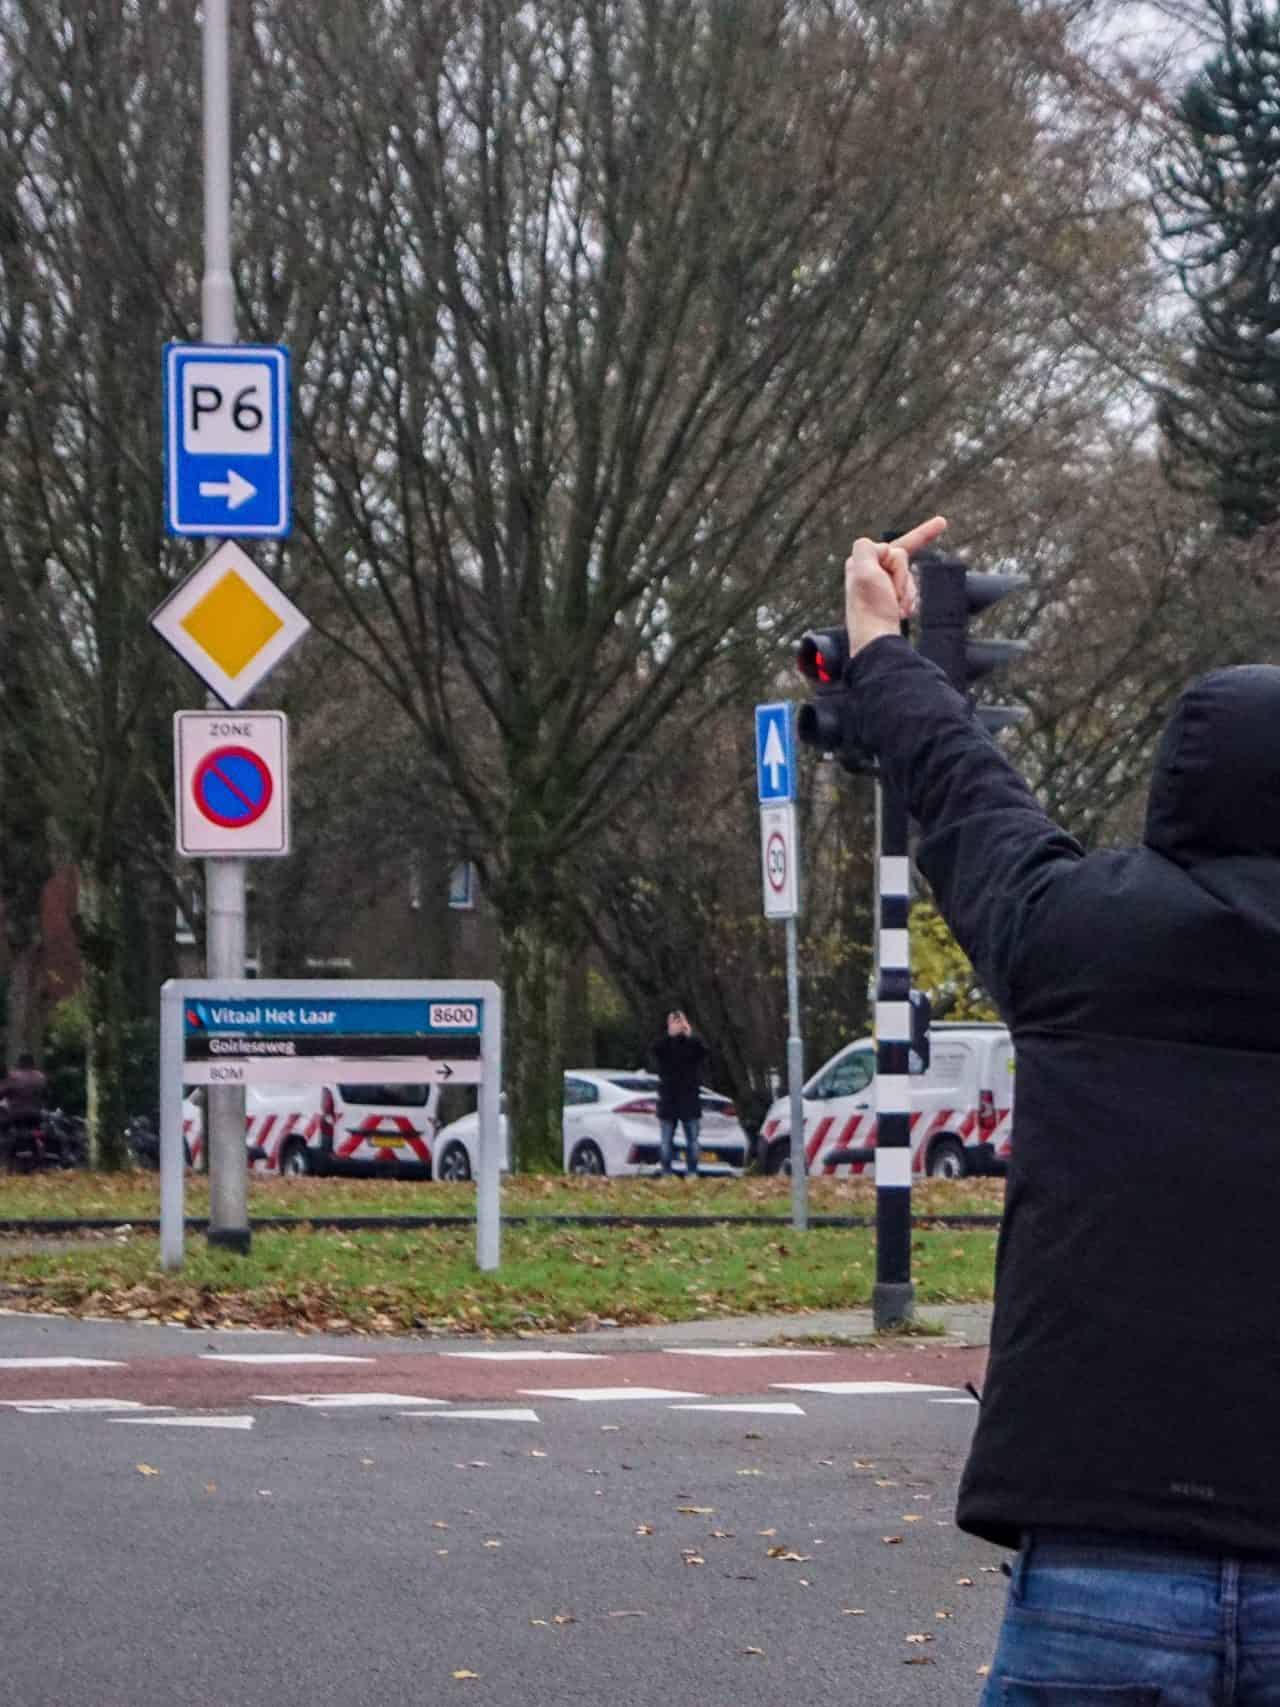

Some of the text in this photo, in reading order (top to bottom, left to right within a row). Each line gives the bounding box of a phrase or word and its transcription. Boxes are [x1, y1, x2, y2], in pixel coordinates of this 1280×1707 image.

[190, 385, 264, 432] P6
[208, 723, 254, 737] ZONE
[211, 1007, 337, 1025] Vitaal Het Laar
[432, 1007, 475, 1023] 8600
[208, 1039, 296, 1056] Goirleseweg
